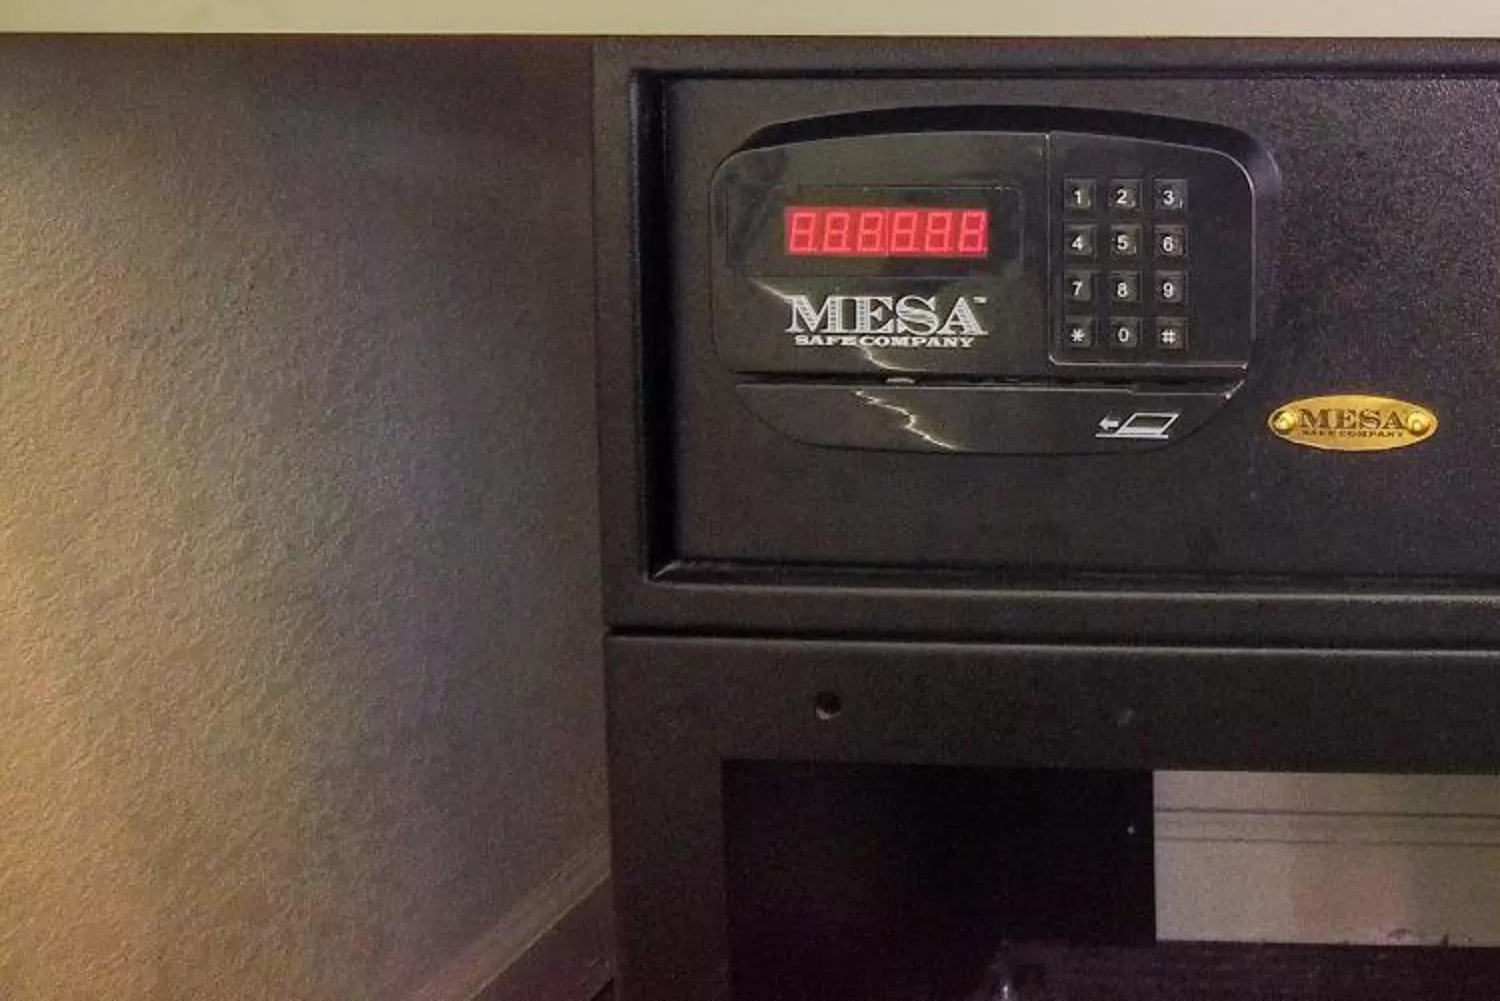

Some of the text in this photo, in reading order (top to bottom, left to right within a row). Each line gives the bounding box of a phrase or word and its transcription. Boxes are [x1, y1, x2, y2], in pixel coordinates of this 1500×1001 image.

[1074, 189, 1174, 205] 1 2 3
[1072, 235, 1174, 252] 4 5 6
[1072, 281, 1174, 298] 7 8 9
[784, 295, 988, 335] MESA
[1299, 408, 1405, 429] MESA
